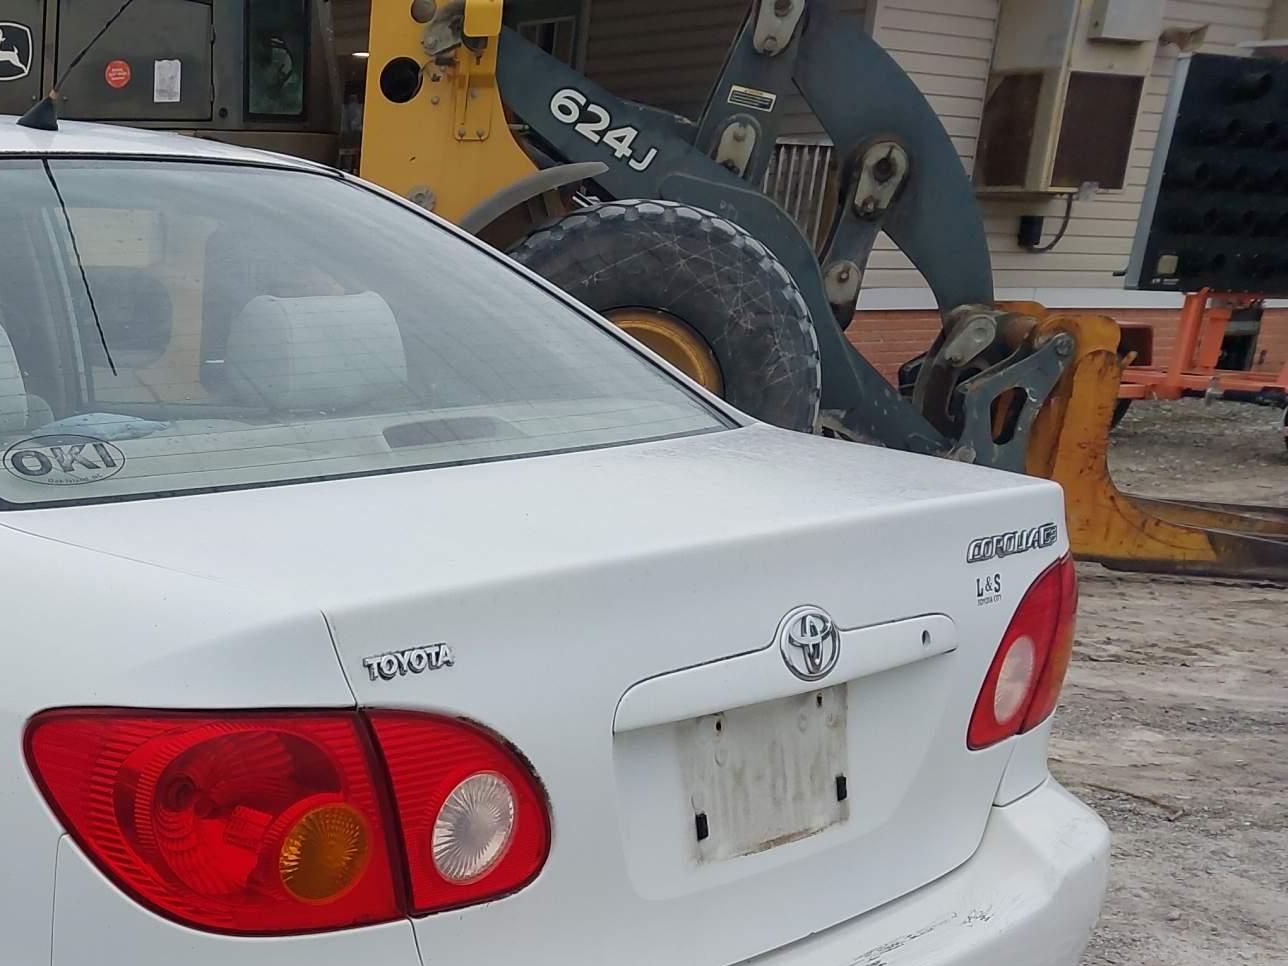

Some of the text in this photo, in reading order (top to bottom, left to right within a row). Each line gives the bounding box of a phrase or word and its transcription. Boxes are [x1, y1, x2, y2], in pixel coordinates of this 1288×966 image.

[550, 88, 658, 171] 624J
[11, 443, 117, 476] OKI
[967, 527, 1040, 563] COROLLA
[363, 643, 454, 681] TOYOTA
